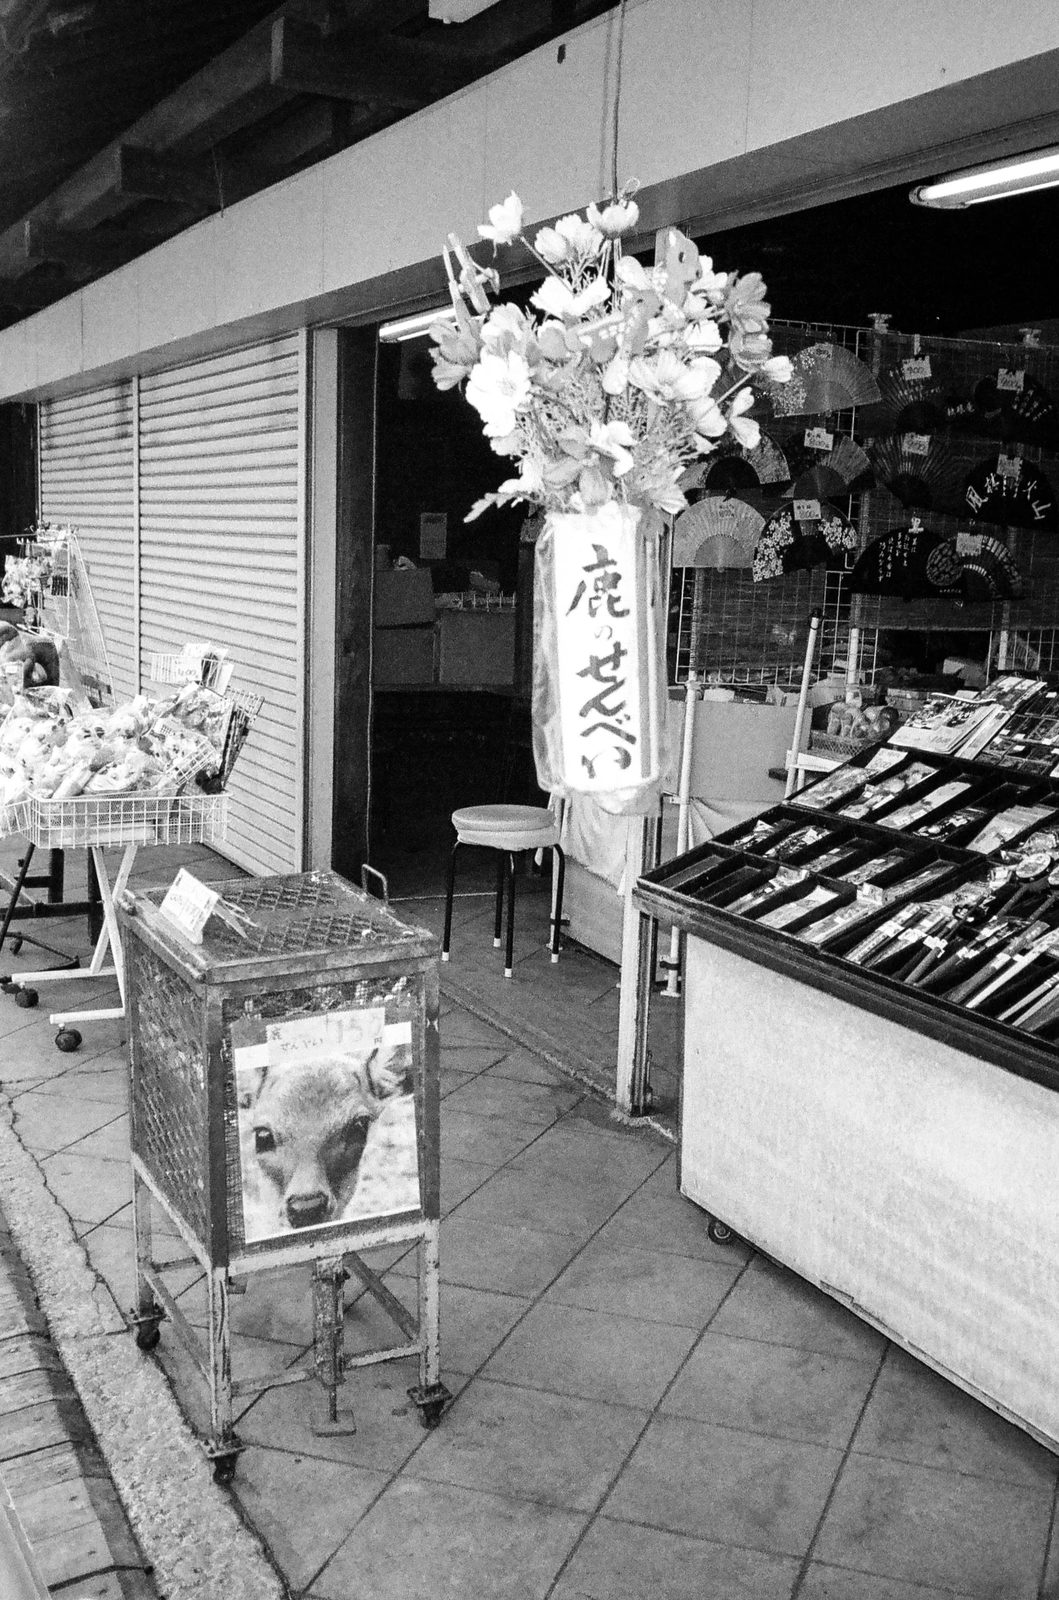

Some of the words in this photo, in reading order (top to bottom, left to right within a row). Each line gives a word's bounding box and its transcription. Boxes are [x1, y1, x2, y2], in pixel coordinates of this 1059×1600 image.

[565, 543, 637, 779] 鹿のせんべい
